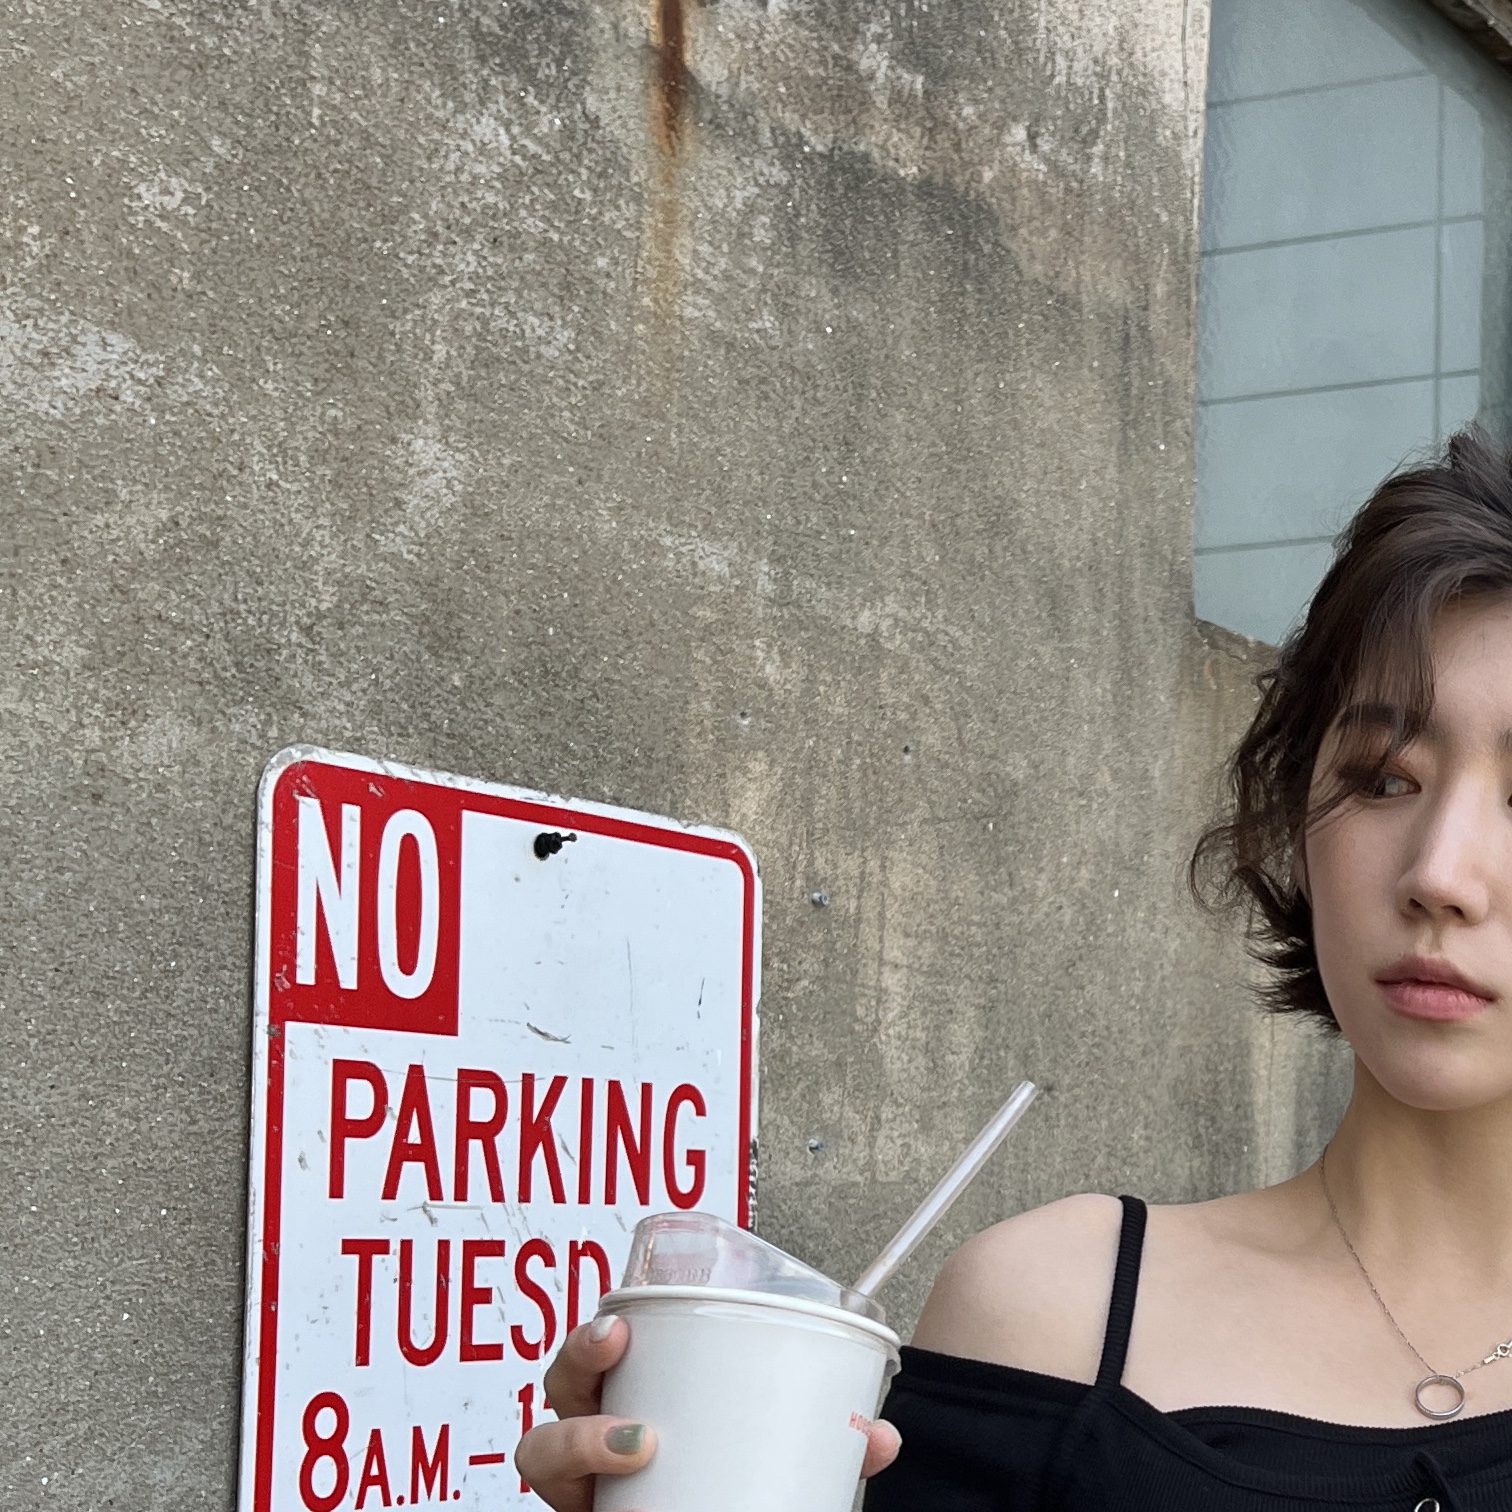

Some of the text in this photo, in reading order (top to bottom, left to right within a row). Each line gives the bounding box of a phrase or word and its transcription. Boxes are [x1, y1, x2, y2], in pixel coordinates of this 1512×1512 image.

[296, 795, 440, 999] NO
[328, 1058, 707, 1210] PARKING
[341, 1238, 613, 1368] TUESD
